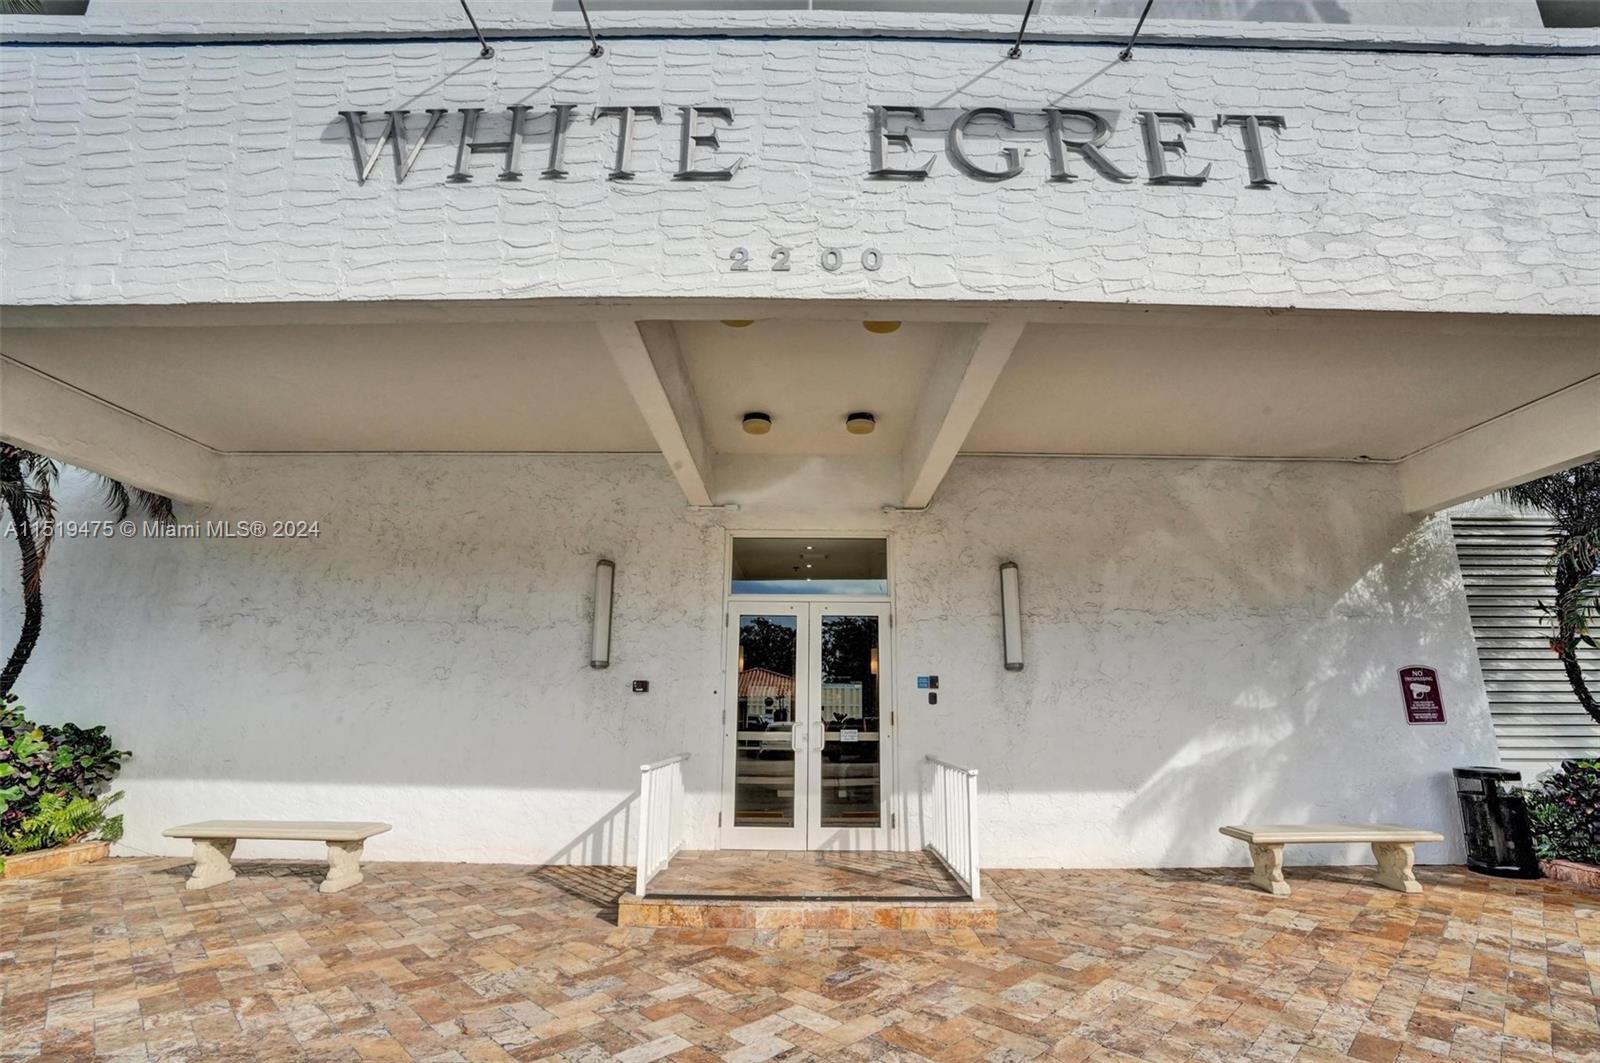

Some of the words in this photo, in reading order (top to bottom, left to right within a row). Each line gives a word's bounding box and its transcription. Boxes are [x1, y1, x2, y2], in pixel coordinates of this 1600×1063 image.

[338, 104, 744, 187] WHITE
[866, 104, 1286, 189] EGRET
[729, 247, 883, 272] 2200
